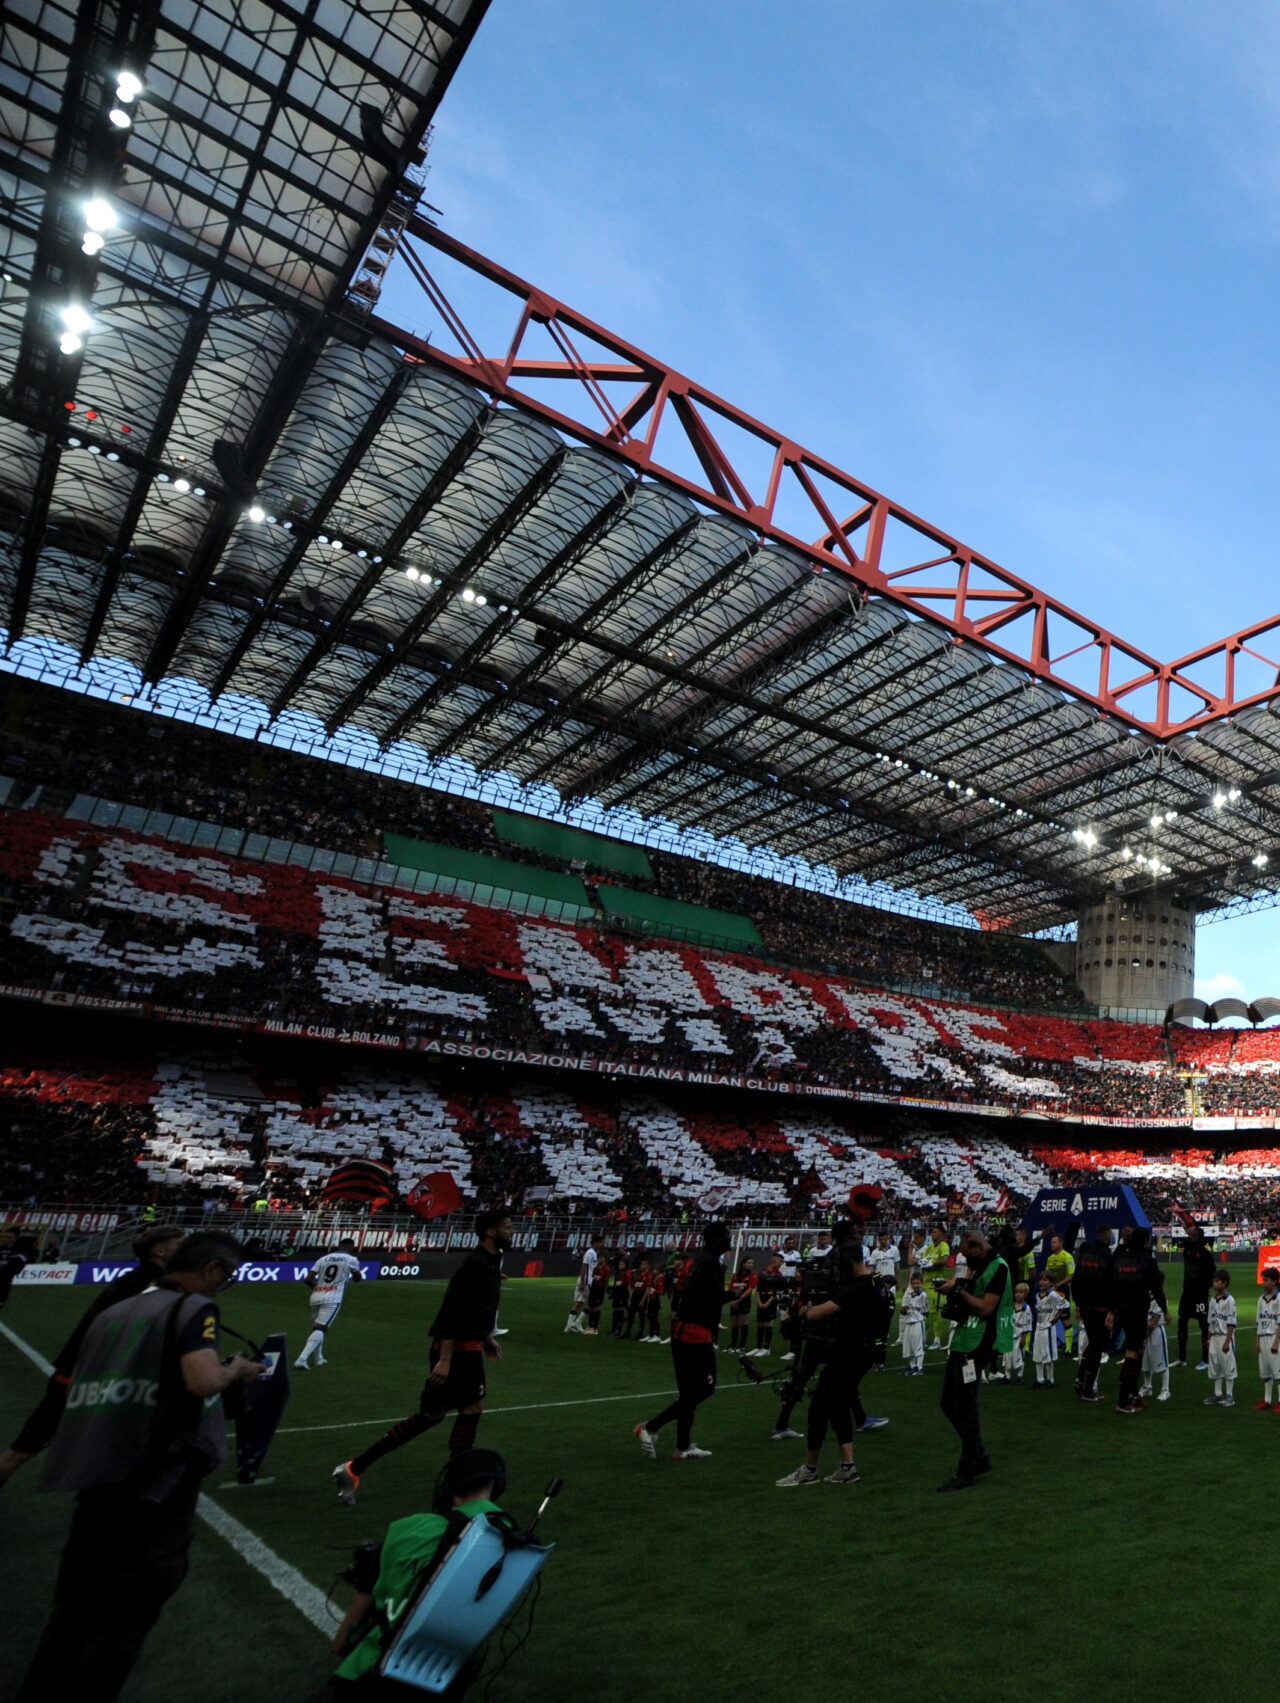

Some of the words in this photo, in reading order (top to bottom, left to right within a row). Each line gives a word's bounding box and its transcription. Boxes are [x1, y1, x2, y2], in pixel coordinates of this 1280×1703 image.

[153, 1004, 185, 1015] MILAN
[186, 1008, 211, 1019] CLUB
[264, 1019, 302, 1035] MILAN
[307, 1025, 336, 1039] CLUB
[352, 1031, 400, 1047] BOLZANO
[424, 1041, 592, 1070] ASSOCIAZIONE
[599, 1061, 684, 1081] ITALIANA
[688, 1072, 742, 1088] MILAN
[746, 1079, 790, 1093] CLUB
[1083, 1115, 1121, 1127] NAVIGLIO
[1134, 1116, 1191, 1128] ROSSONERO
[1040, 1199, 1067, 1212] SERIE
[1098, 1196, 1118, 1210] TIM
[23, 1211, 77, 1231] JUNIOR
[78, 1213, 119, 1232] CLUB
[292, 1229, 363, 1247] ITALIANA
[364, 1231, 408, 1247] MILAN
[414, 1231, 447, 1248] CLUB
[511, 1233, 540, 1247] ILAN
[566, 1233, 613, 1248] MILN
[617, 1233, 683, 1248] ACADEMY
[324, 1264, 338, 1283] 9
[379, 1265, 420, 1276] 00:00
[1195, 1303, 1206, 1313] 20
[201, 1316, 216, 1340] 2
